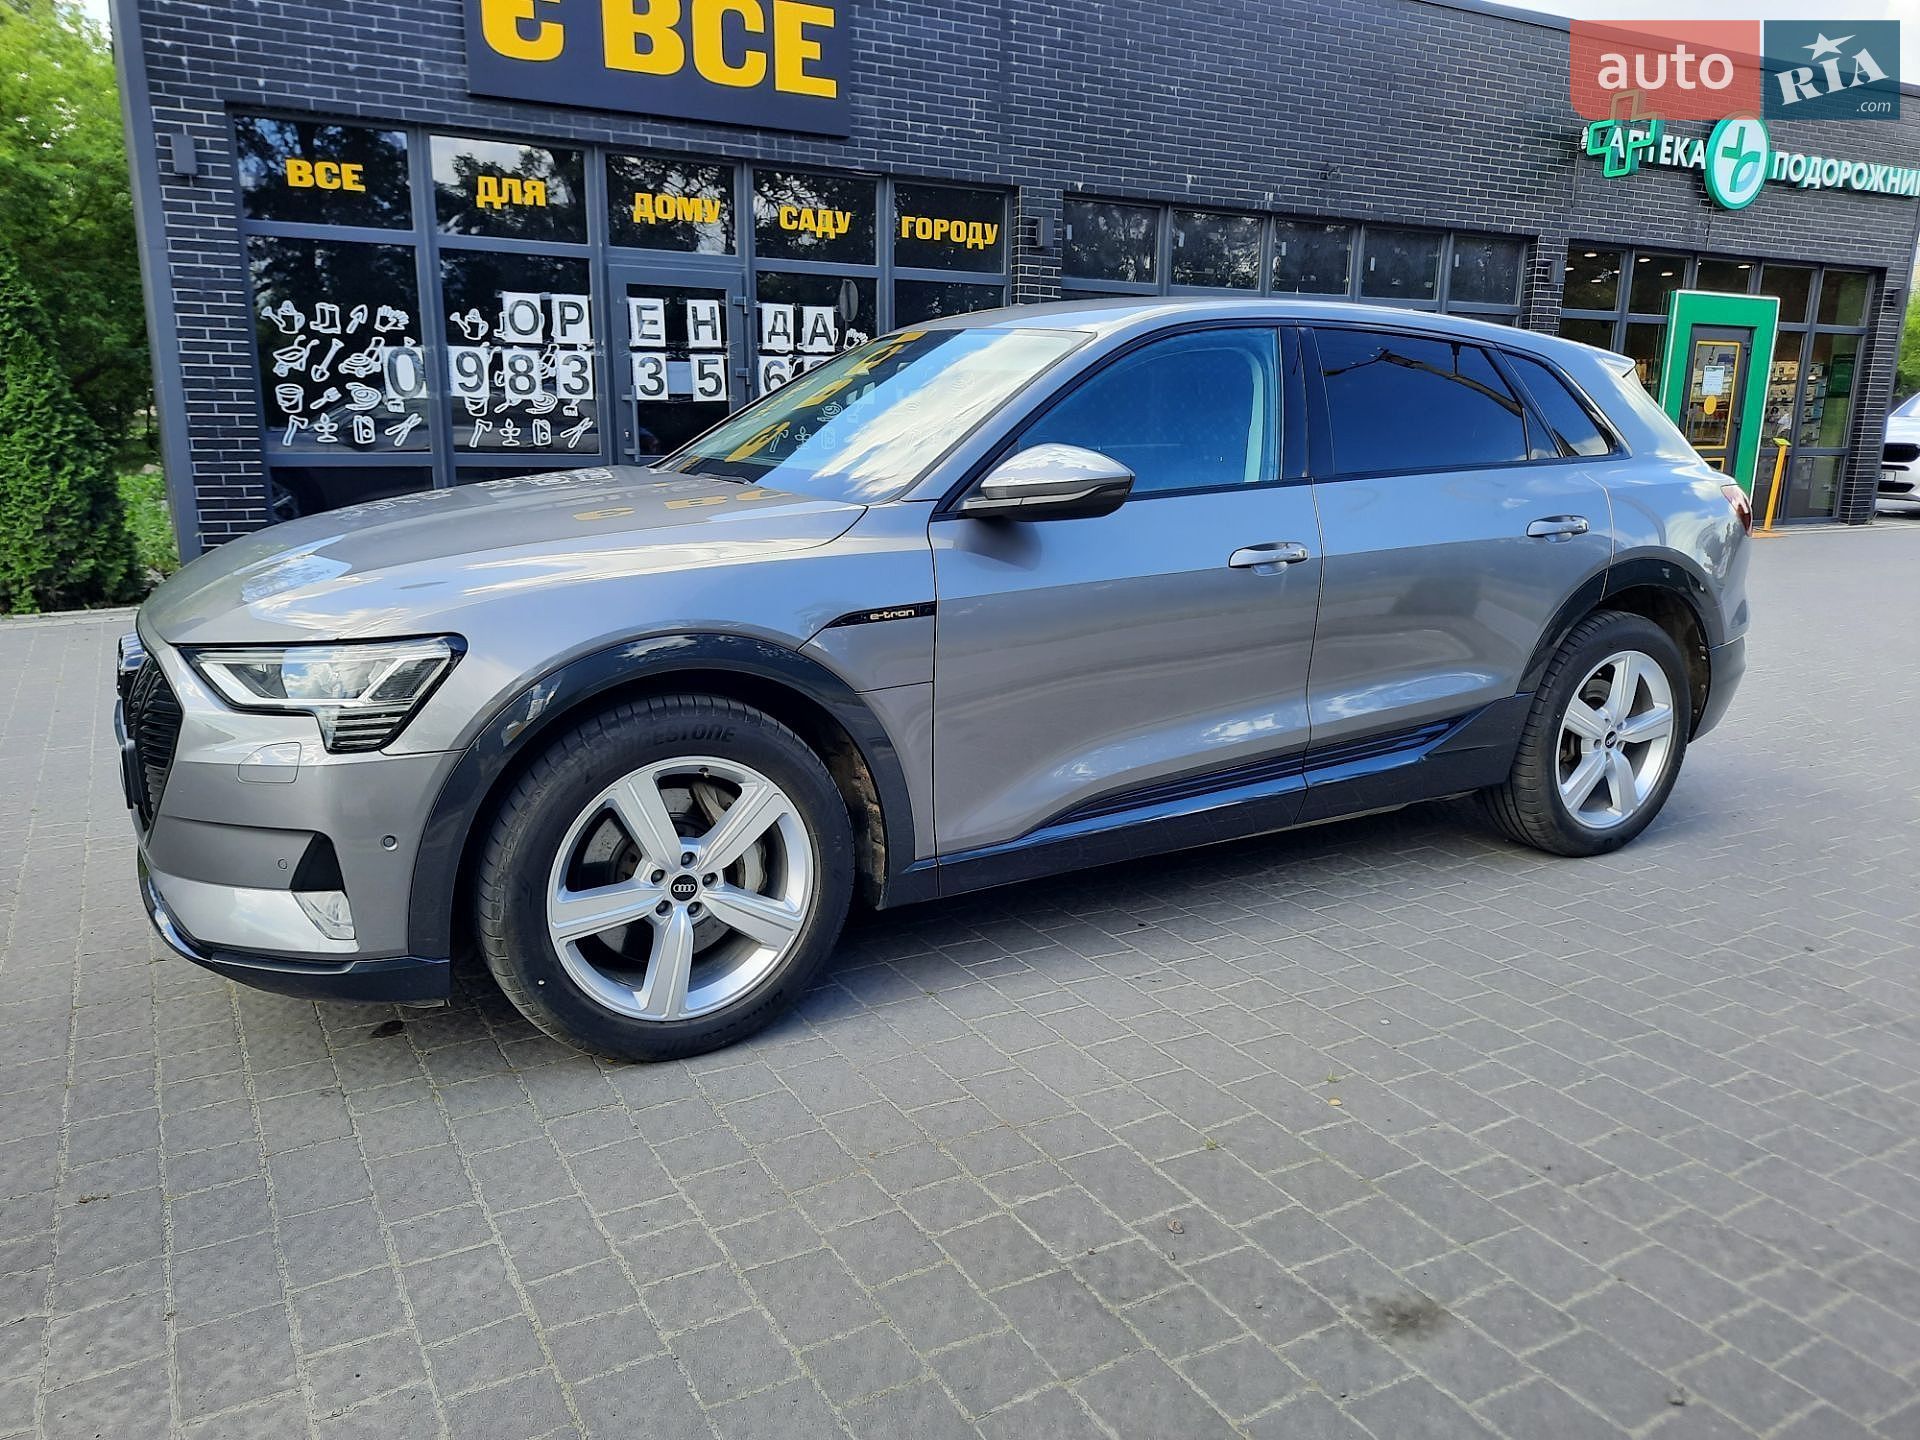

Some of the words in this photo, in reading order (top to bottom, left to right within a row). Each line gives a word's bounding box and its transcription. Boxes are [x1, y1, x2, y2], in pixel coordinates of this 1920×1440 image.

[601, 0, 838, 99] ВСЕ
[285, 159, 366, 192] ВСЕ
[476, 175, 546, 210] ДЛЯ
[633, 192, 721, 224] ДОМУ
[779, 205, 851, 240] САДУ
[901, 215, 998, 250] ГОРОДУ
[1772, 151, 1920, 197] ПОДОРОЖНИ
[869, 608, 915, 621] e-tron
